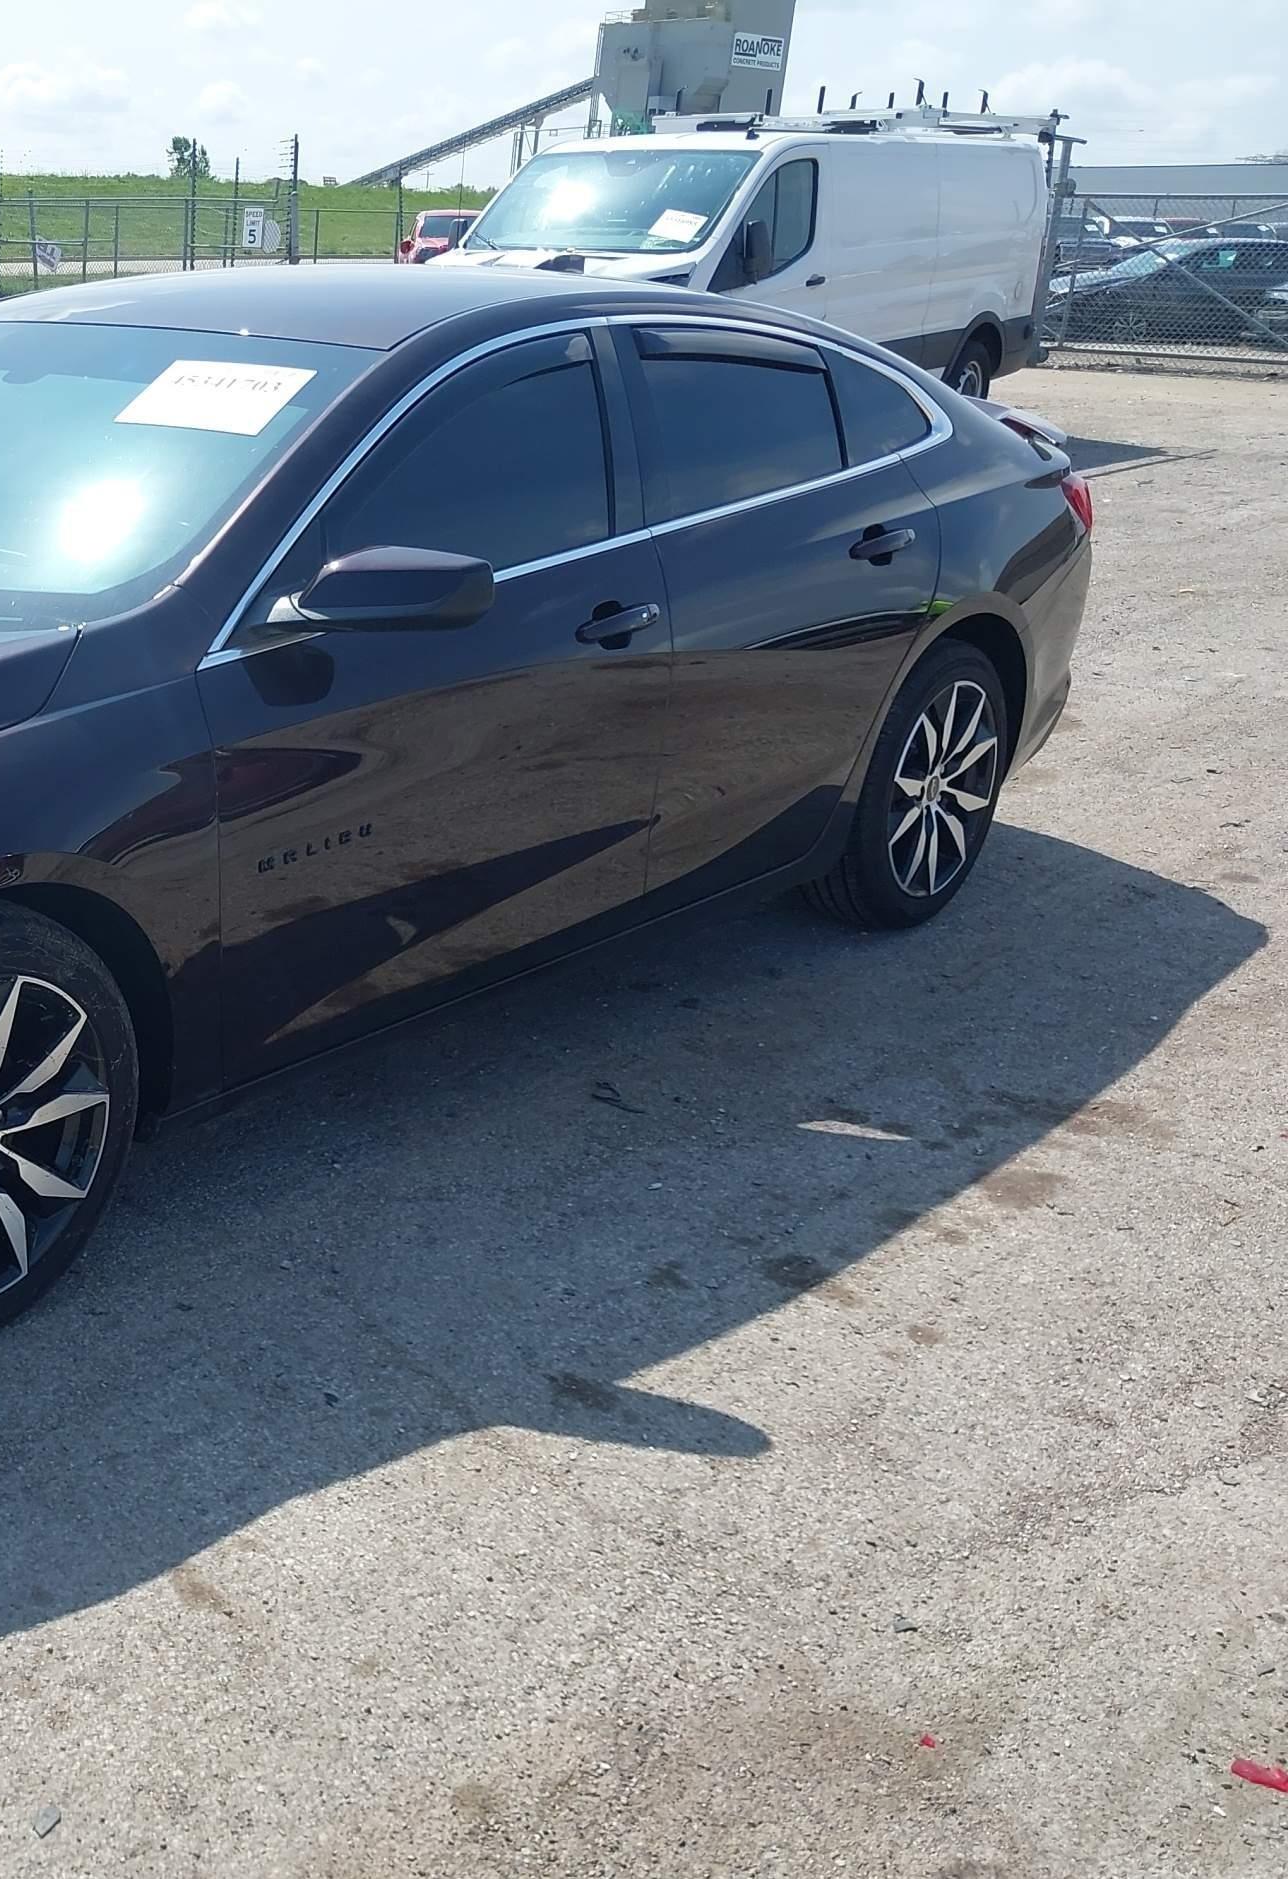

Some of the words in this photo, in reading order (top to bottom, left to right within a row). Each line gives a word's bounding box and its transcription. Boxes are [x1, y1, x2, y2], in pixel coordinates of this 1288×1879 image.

[734, 37, 782, 57] ROANOKE
[732, 57, 756, 66] CONCRETE
[757, 60, 780, 69] PRODUCTS
[247, 229, 257, 244] 5
[257, 823, 372, 874] MALIBU
